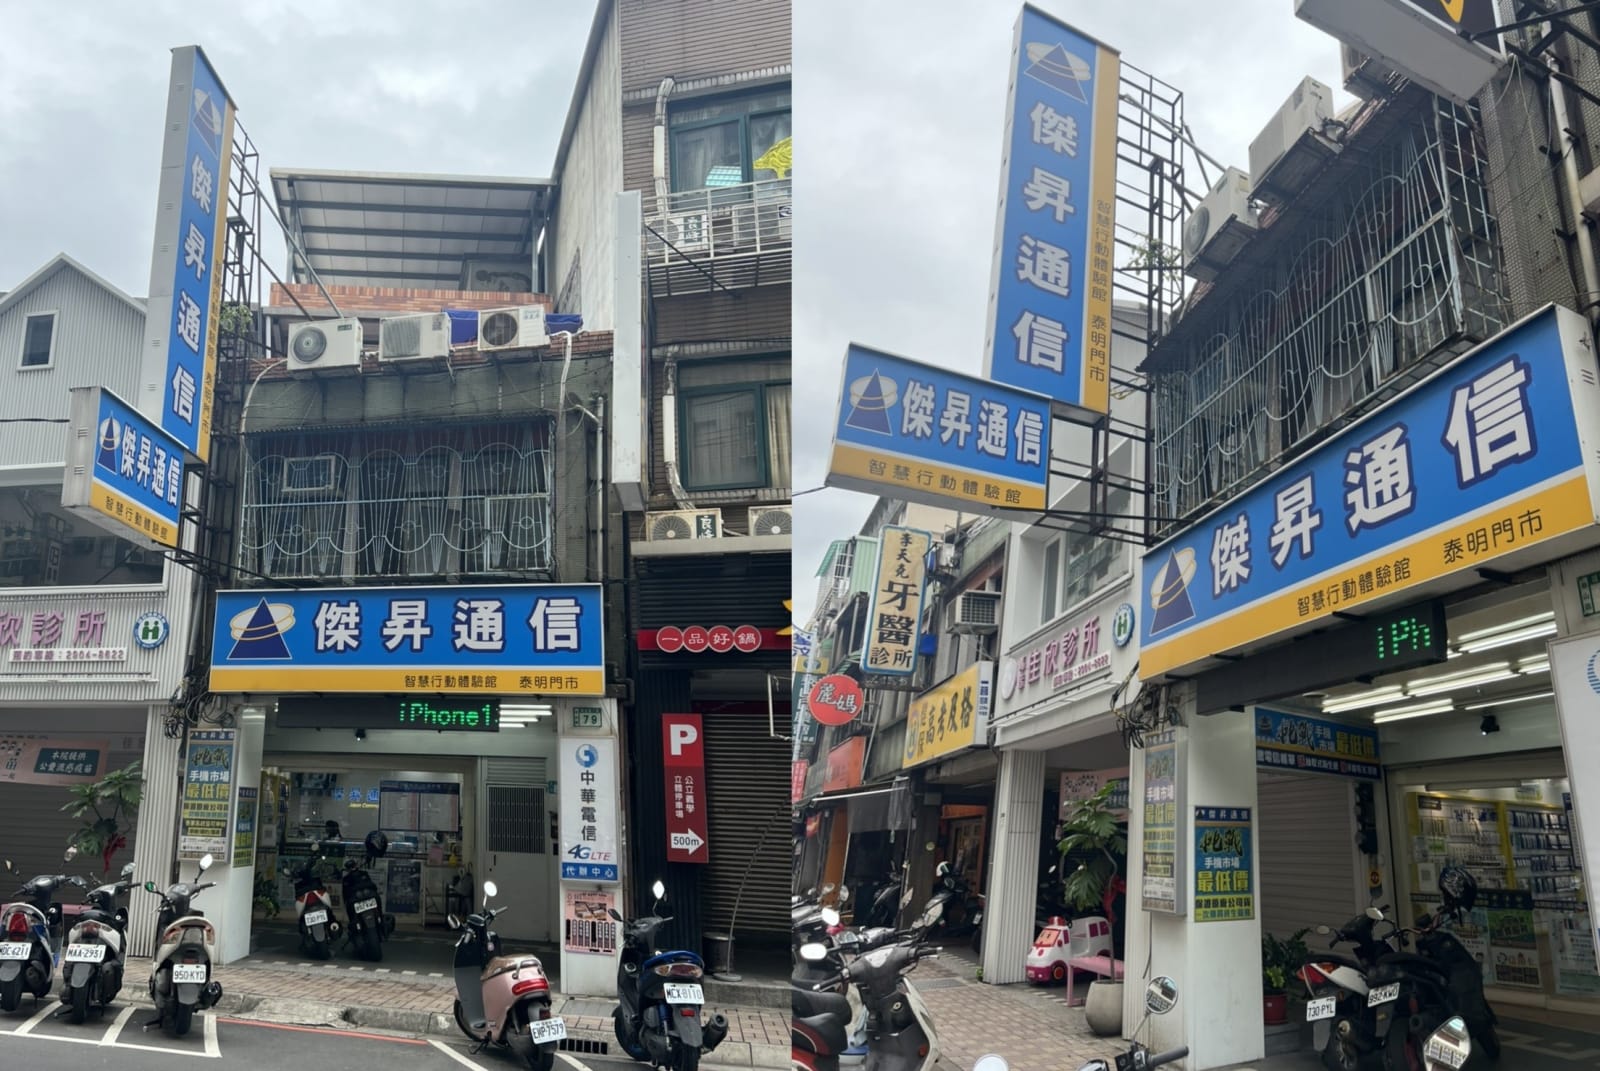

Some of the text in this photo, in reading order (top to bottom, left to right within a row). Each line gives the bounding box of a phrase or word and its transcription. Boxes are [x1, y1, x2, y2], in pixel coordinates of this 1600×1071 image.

[1012, 101, 1078, 374] 傑昇通信
[170, 154, 212, 424] 傑昇通信
[1089, 314, 1107, 382] 泰明門市
[902, 379, 1043, 466] 傑昇通信
[121, 424, 180, 506] 傑昇通信
[868, 459, 1021, 504] 智慧行動體驗館
[1210, 358, 1532, 595] 傑昇通信
[1297, 509, 1544, 617] 智慧行動體驗館 泰明門市
[314, 598, 581, 652] 傑昇通信
[877, 580, 920, 647] 牙醫
[661, 632, 757, 646] 一品好鍋
[870, 647, 913, 668] 診所
[404, 675, 579, 689] 智慧行動體驗館 泰明門市
[400, 703, 498, 727] iPhone1
[583, 714, 598, 725] 79
[669, 723, 698, 756] P
[580, 770, 597, 842] 中華電信
[568, 844, 612, 861] 4G LTE
[673, 836, 699, 847] 500m
[1204, 857, 1240, 869] 手機市場
[1197, 870, 1250, 893] 最低價
